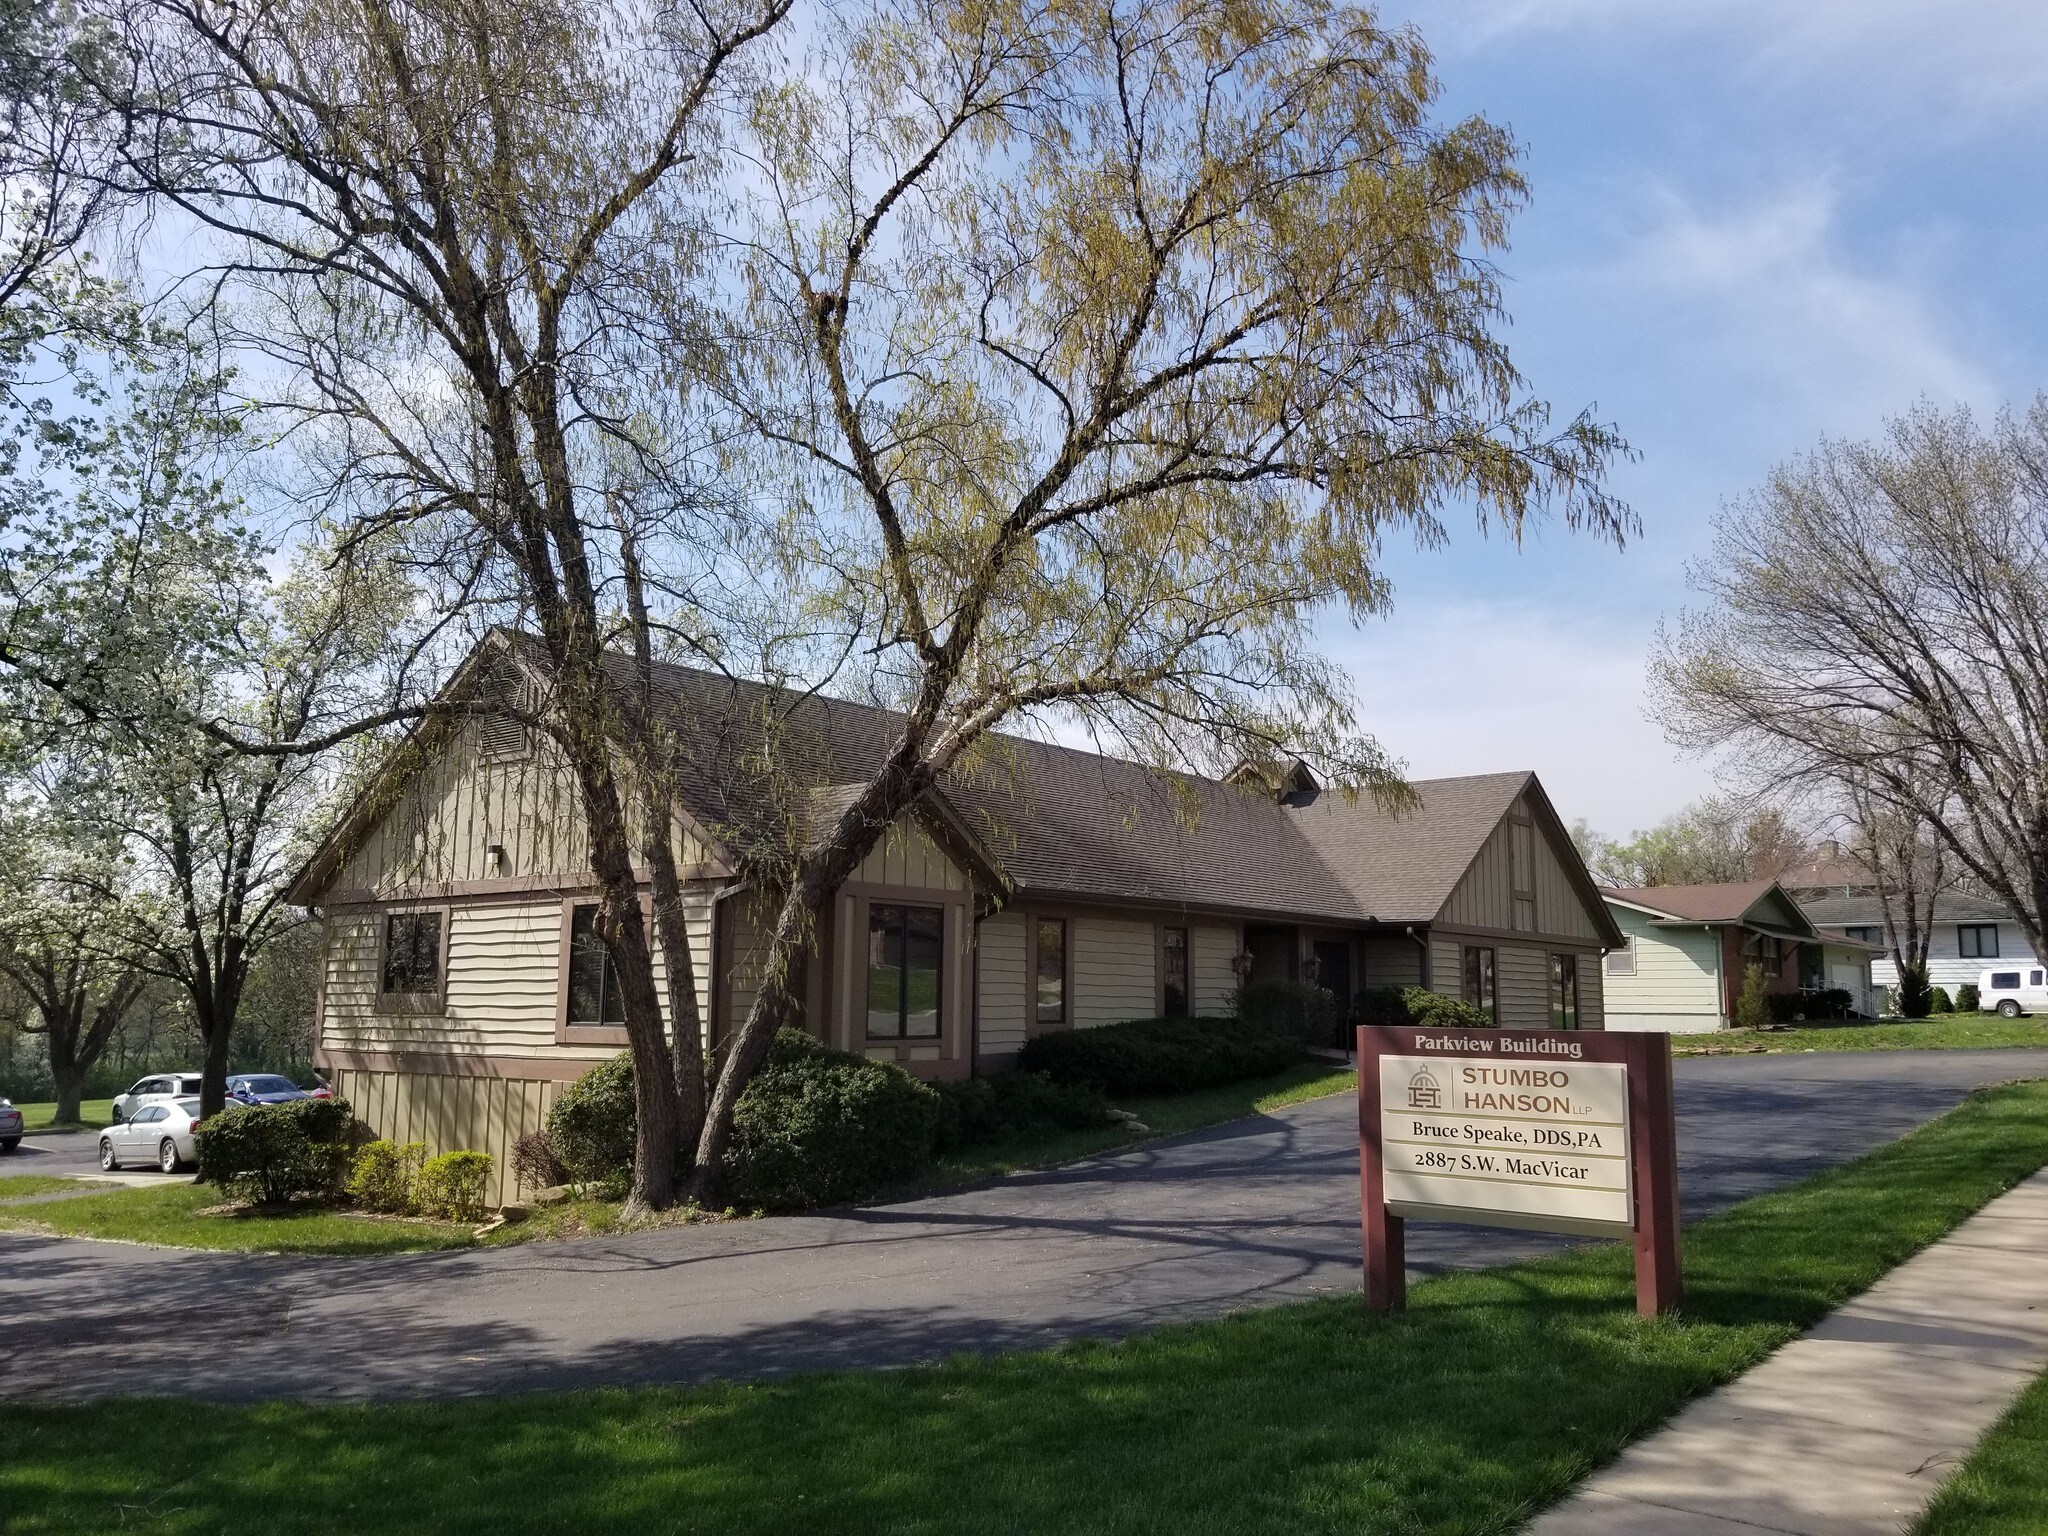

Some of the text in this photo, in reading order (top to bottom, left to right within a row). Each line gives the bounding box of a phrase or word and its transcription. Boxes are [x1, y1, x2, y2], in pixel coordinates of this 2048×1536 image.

[1415, 1035, 1583, 1059] Parkview Building
[1462, 1067, 1569, 1088] STUMBO
[1464, 1092, 1593, 1115] HANSON LLP
[1412, 1121, 1459, 1138] Bruce
[1463, 1124, 1528, 1146] Speake,
[1415, 1152, 1589, 1180] 2887 S.W. MacVicar
